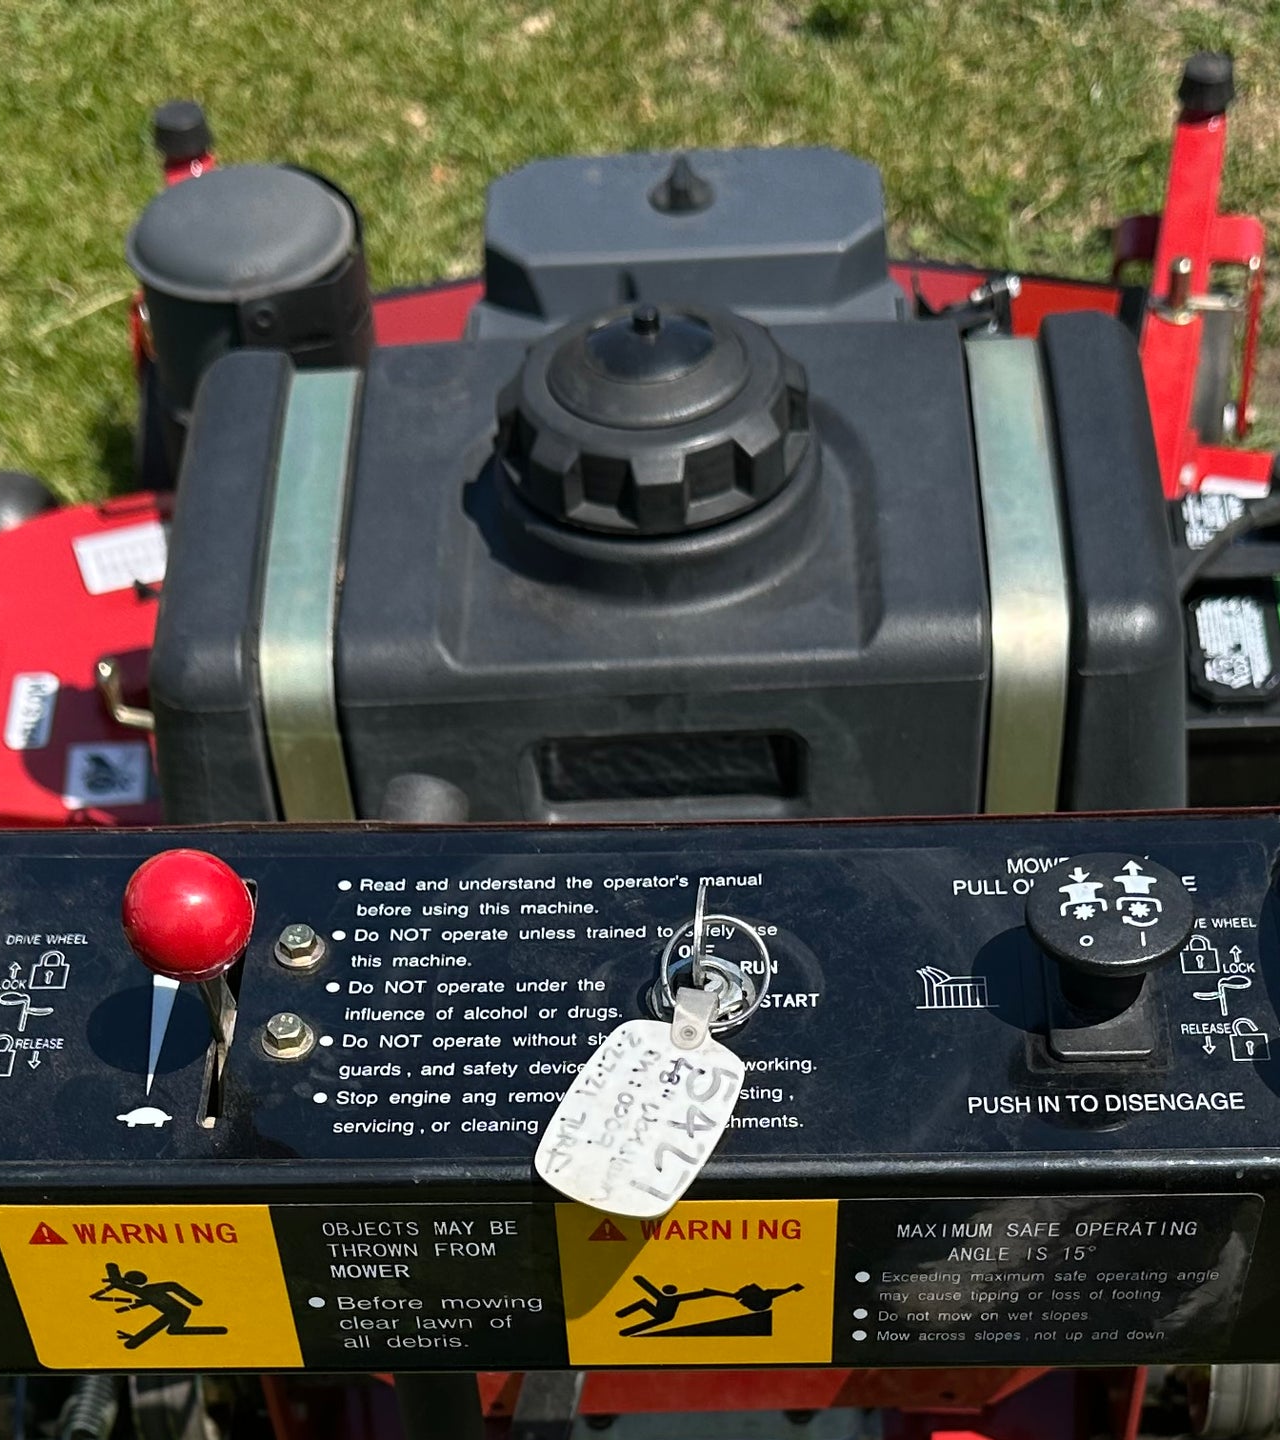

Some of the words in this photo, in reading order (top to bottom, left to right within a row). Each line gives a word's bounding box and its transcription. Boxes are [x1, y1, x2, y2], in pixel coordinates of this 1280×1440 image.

[1006, 857, 1070, 874] MOW
[359, 878, 406, 892] Read
[415, 877, 449, 891] and
[458, 876, 556, 891] understand
[565, 876, 593, 889] the
[603, 874, 689, 891] operator's
[699, 873, 763, 887] manual
[952, 879, 1009, 896] PULL
[356, 903, 412, 917] before
[422, 902, 469, 919] using
[479, 902, 510, 916] this
[520, 901, 599, 915] machine.
[1210, 917, 1257, 929] WHEEL
[5, 933, 42, 946] DRIVE
[46, 933, 89, 945] WHEEL
[354, 928, 380, 942] Do
[389, 927, 432, 942] NOT
[441, 928, 509, 944] operate
[519, 926, 576, 940] unless
[586, 925, 647, 939] trained
[656, 925, 674, 938] to
[685, 924, 735, 940] sfely
[678, 944, 716, 959] OF
[351, 954, 382, 968] this
[392, 953, 472, 968] machine.
[740, 960, 780, 975] RUN
[1222, 962, 1256, 974] LOCK
[348, 980, 374, 994] Do
[384, 979, 428, 994] NOT
[436, 980, 505, 996] operate
[515, 978, 568, 993] under
[577, 978, 606, 992] the
[760, 993, 820, 1008] START
[344, 1007, 426, 1021] influence
[435, 1006, 454, 1021] of
[463, 1005, 528, 1020] alcohol
[538, 1008, 558, 1019] or
[567, 1005, 623, 1022] drugs.
[1179, 1021, 1232, 1036] RELEASE
[14, 1037, 65, 1050] RELEASE
[342, 1033, 369, 1049] Do
[379, 1033, 423, 1049] NOT
[432, 1034, 502, 1051] operate
[512, 1032, 577, 1047] without
[420, 1062, 455, 1076] and
[462, 1061, 519, 1078] safety
[528, 1060, 587, 1075] device
[743, 1055, 819, 1075] working.
[335, 1090, 379, 1108] Stop
[388, 1089, 452, 1108] engine
[461, 1092, 497, 1107] ang
[508, 1091, 567, 1103] remov
[739, 1085, 784, 1103] sting
[967, 1095, 1031, 1114] PUSH
[1037, 1095, 1060, 1114] IN
[1065, 1094, 1099, 1113] TO
[1104, 1092, 1246, 1112] DISENGAGE
[430, 1121, 451, 1133] or
[460, 1117, 539, 1135] cleaning
[630, 1067, 739, 1201] 5427
[72, 1221, 240, 1246] WARNING
[322, 1221, 419, 1237] OBJECTS
[433, 1220, 475, 1236] MAY
[489, 1220, 518, 1235] BE
[640, 1219, 802, 1241] WARNING
[896, 1223, 993, 1238] MAXIMUM
[1006, 1222, 1060, 1238] SAFE
[1075, 1221, 1198, 1237] OPERATING
[326, 1243, 419, 1258] THROWN
[434, 1242, 496, 1257] FROM
[947, 1246, 1010, 1262] ANGLE
[1027, 1246, 1048, 1261] IS
[330, 1264, 411, 1279] MOWER
[881, 1270, 961, 1285] Exceeding
[970, 1271, 1046, 1283] maximum
[1053, 1270, 1087, 1282] safe
[1096, 1270, 1168, 1284] operating
[1176, 1269, 1220, 1284] angle
[336, 1295, 423, 1311] Before
[440, 1294, 544, 1313] mowing
[879, 1291, 911, 1304] may
[918, 1291, 962, 1301] cause
[970, 1290, 1019, 1304] tipping
[1027, 1291, 1044, 1301] or
[1051, 1289, 1081, 1301] loss
[1089, 1288, 1104, 1301] of
[339, 1315, 400, 1330] clear
[415, 1315, 473, 1330] lawn
[489, 1314, 512, 1329] of
[878, 1310, 899, 1322] Do
[906, 1310, 930, 1322] not
[937, 1312, 973, 1322] mow
[980, 1312, 999, 1321] on
[1007, 1311, 1033, 1321] wet
[344, 1334, 370, 1349] all
[386, 1334, 469, 1349] debris.
[876, 1330, 911, 1341] Mow
[918, 1332, 966, 1341] across
[1033, 1330, 1057, 1341] not
[1065, 1331, 1083, 1343] up
[1091, 1329, 1119, 1341] and
